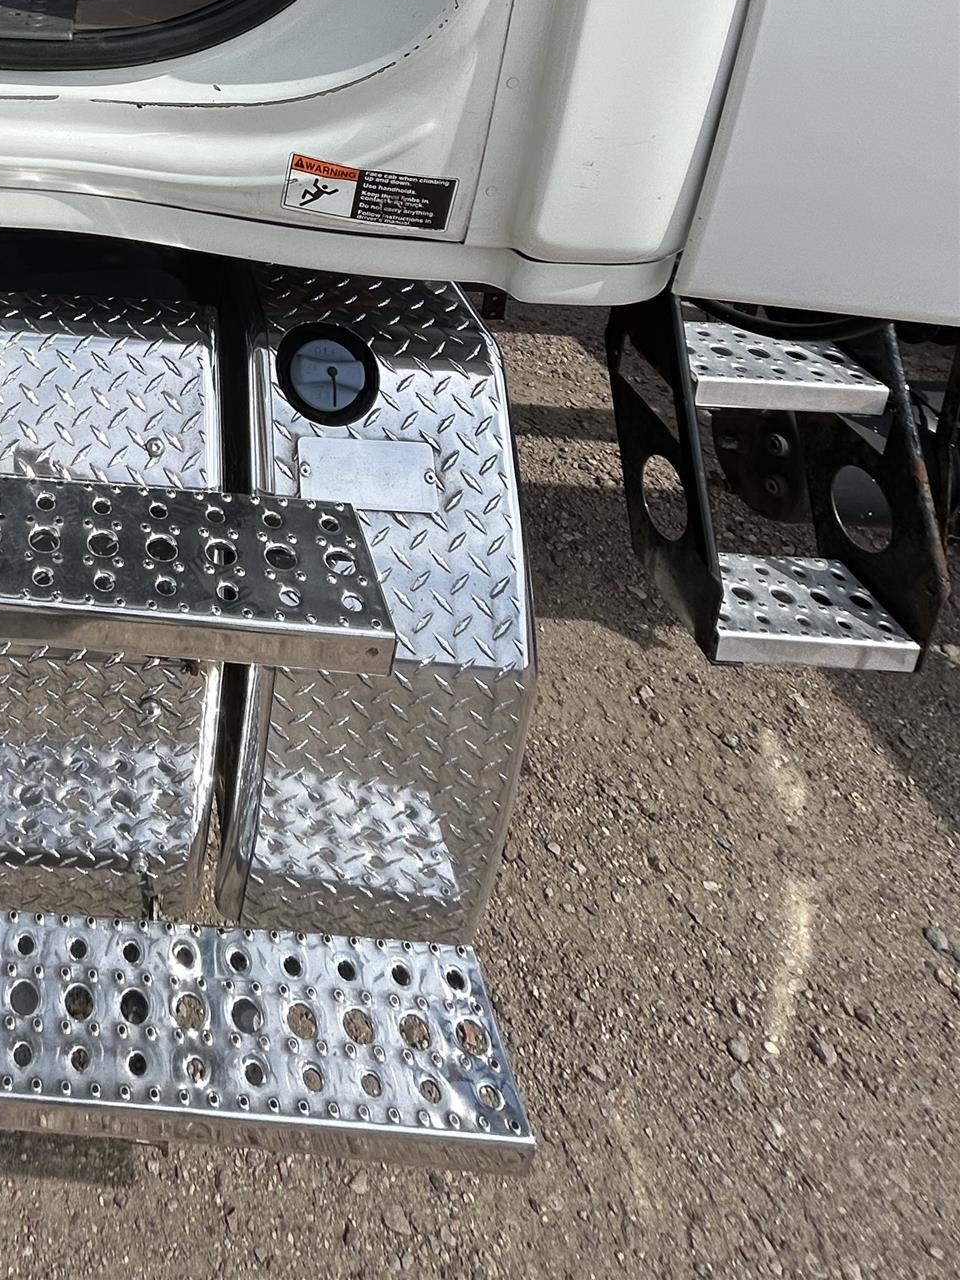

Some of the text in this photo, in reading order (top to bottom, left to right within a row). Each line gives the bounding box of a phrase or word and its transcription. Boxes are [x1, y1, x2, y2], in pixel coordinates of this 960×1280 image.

[305, 161, 357, 179] WARNING
[362, 182, 378, 190] Use
[419, 178, 450, 187] climbing
[361, 190, 380, 198] Keep
